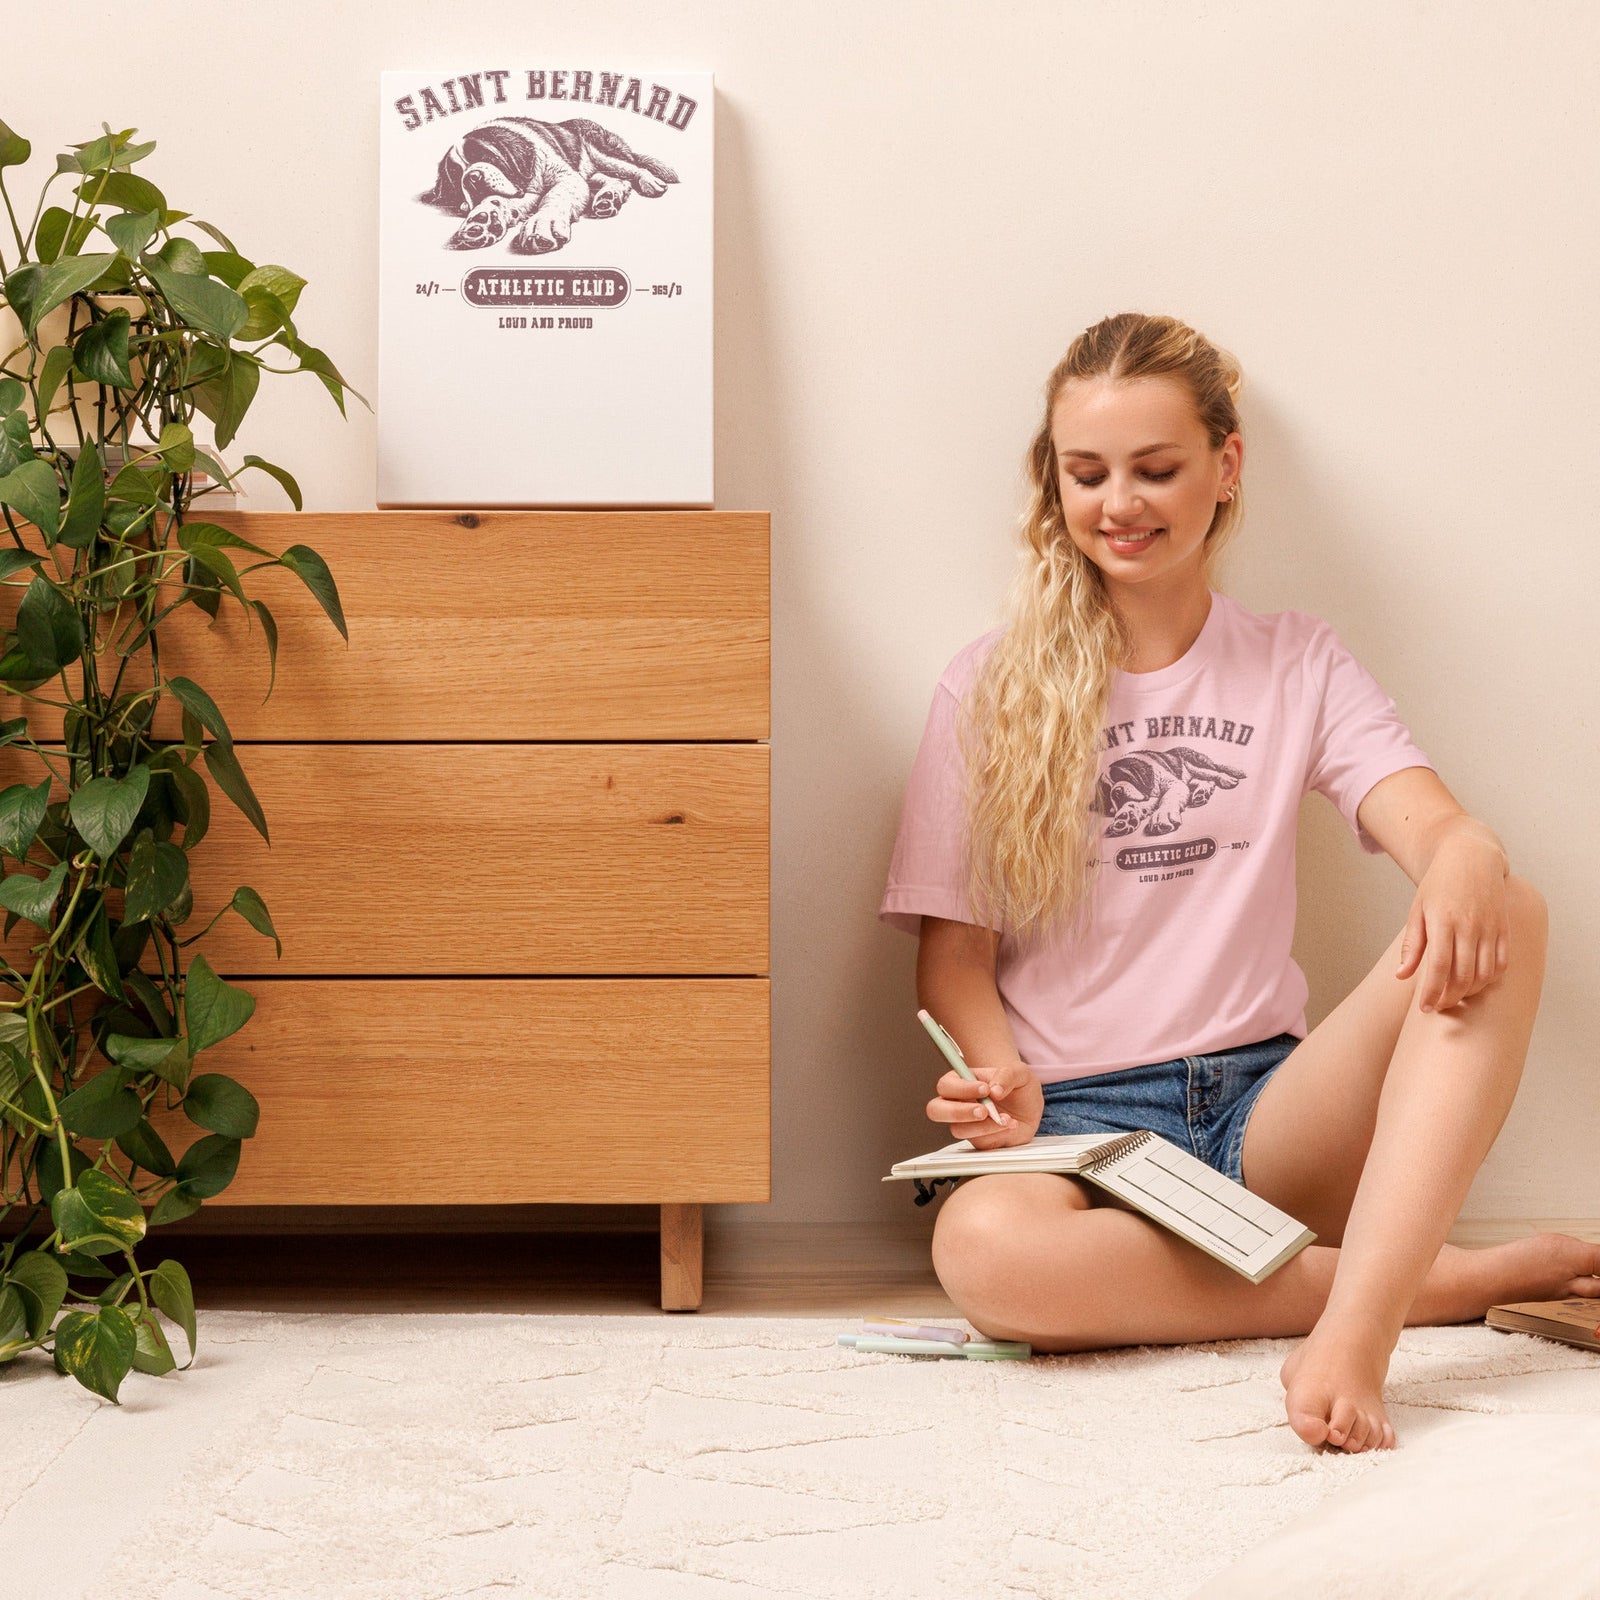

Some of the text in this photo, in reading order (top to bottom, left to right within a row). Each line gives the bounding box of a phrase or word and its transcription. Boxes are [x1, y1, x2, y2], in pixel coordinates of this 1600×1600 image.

[395, 70, 699, 132] SAINT BERNARD
[416, 279, 682, 298] 24/7 ATHLETIC CLUB 365/D
[498, 317, 593, 330] LOUD AND PROUD
[1145, 715, 1255, 746] BERNARD
[1124, 849, 1181, 865] ATHLETIC
[1184, 843, 1208, 858] CLUB
[1139, 874, 1159, 883] LOUD
